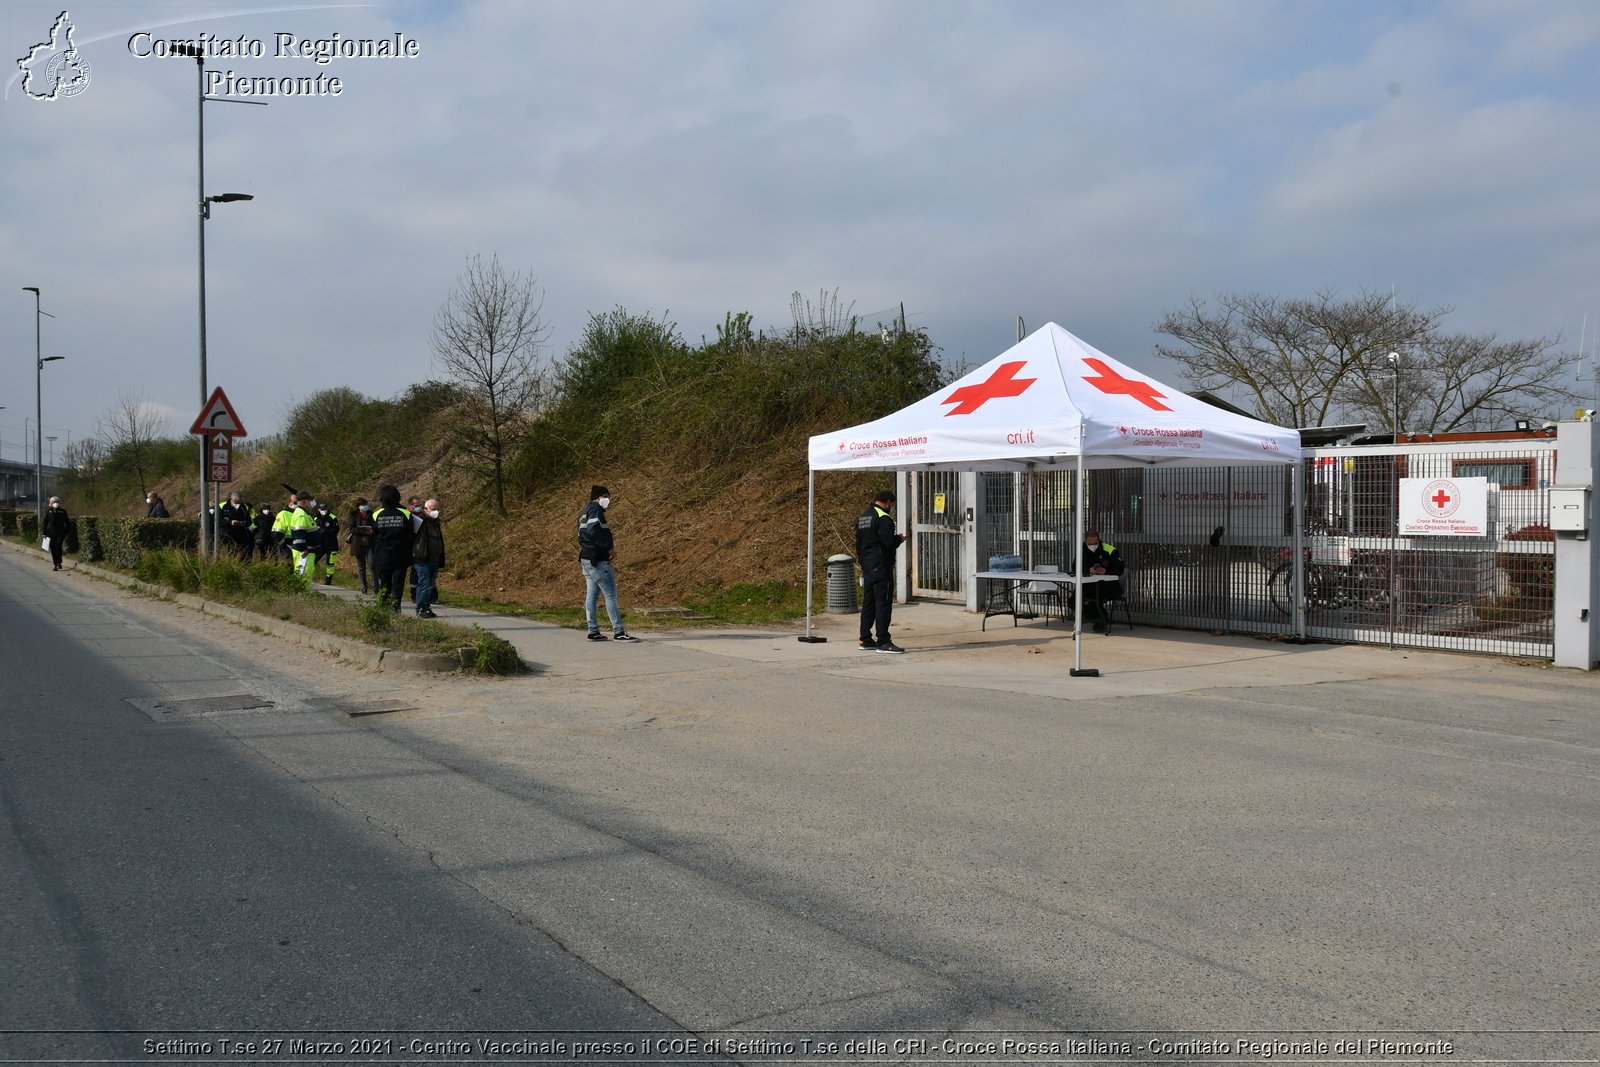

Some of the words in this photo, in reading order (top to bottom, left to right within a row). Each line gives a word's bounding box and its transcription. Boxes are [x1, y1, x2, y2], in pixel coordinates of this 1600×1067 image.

[1007, 428, 1034, 444] cri.it
[1132, 426, 1154, 436] Croce
[1155, 428, 1178, 437] Rossa
[850, 442, 870, 450] Croce
[872, 440, 896, 449] Rossa
[898, 436, 928, 446] Italiana
[1174, 491, 1200, 500] Croce
